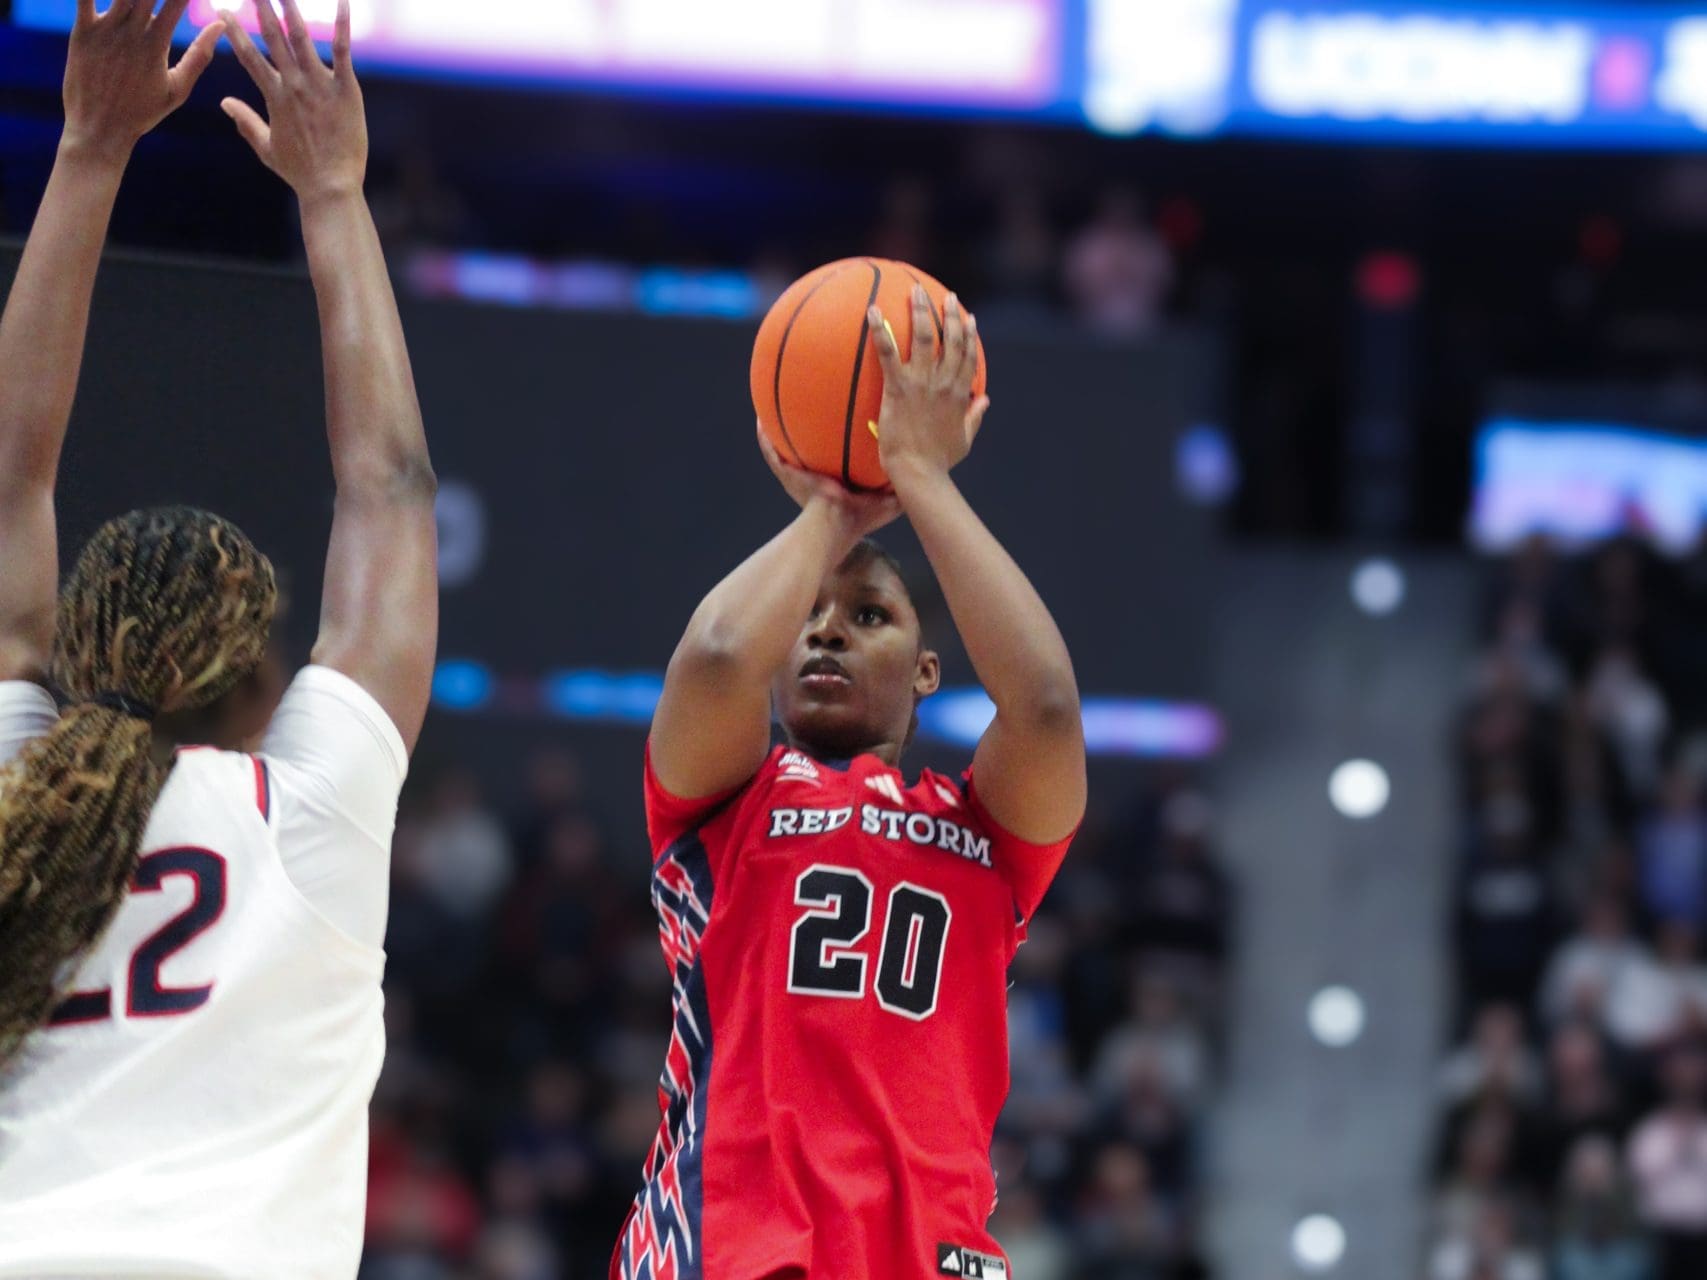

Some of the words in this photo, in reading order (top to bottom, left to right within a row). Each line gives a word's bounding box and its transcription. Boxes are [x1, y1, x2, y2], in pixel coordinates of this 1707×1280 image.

[769, 807, 853, 837] RED
[861, 803, 993, 868] STORM
[787, 863, 952, 1022] 20
